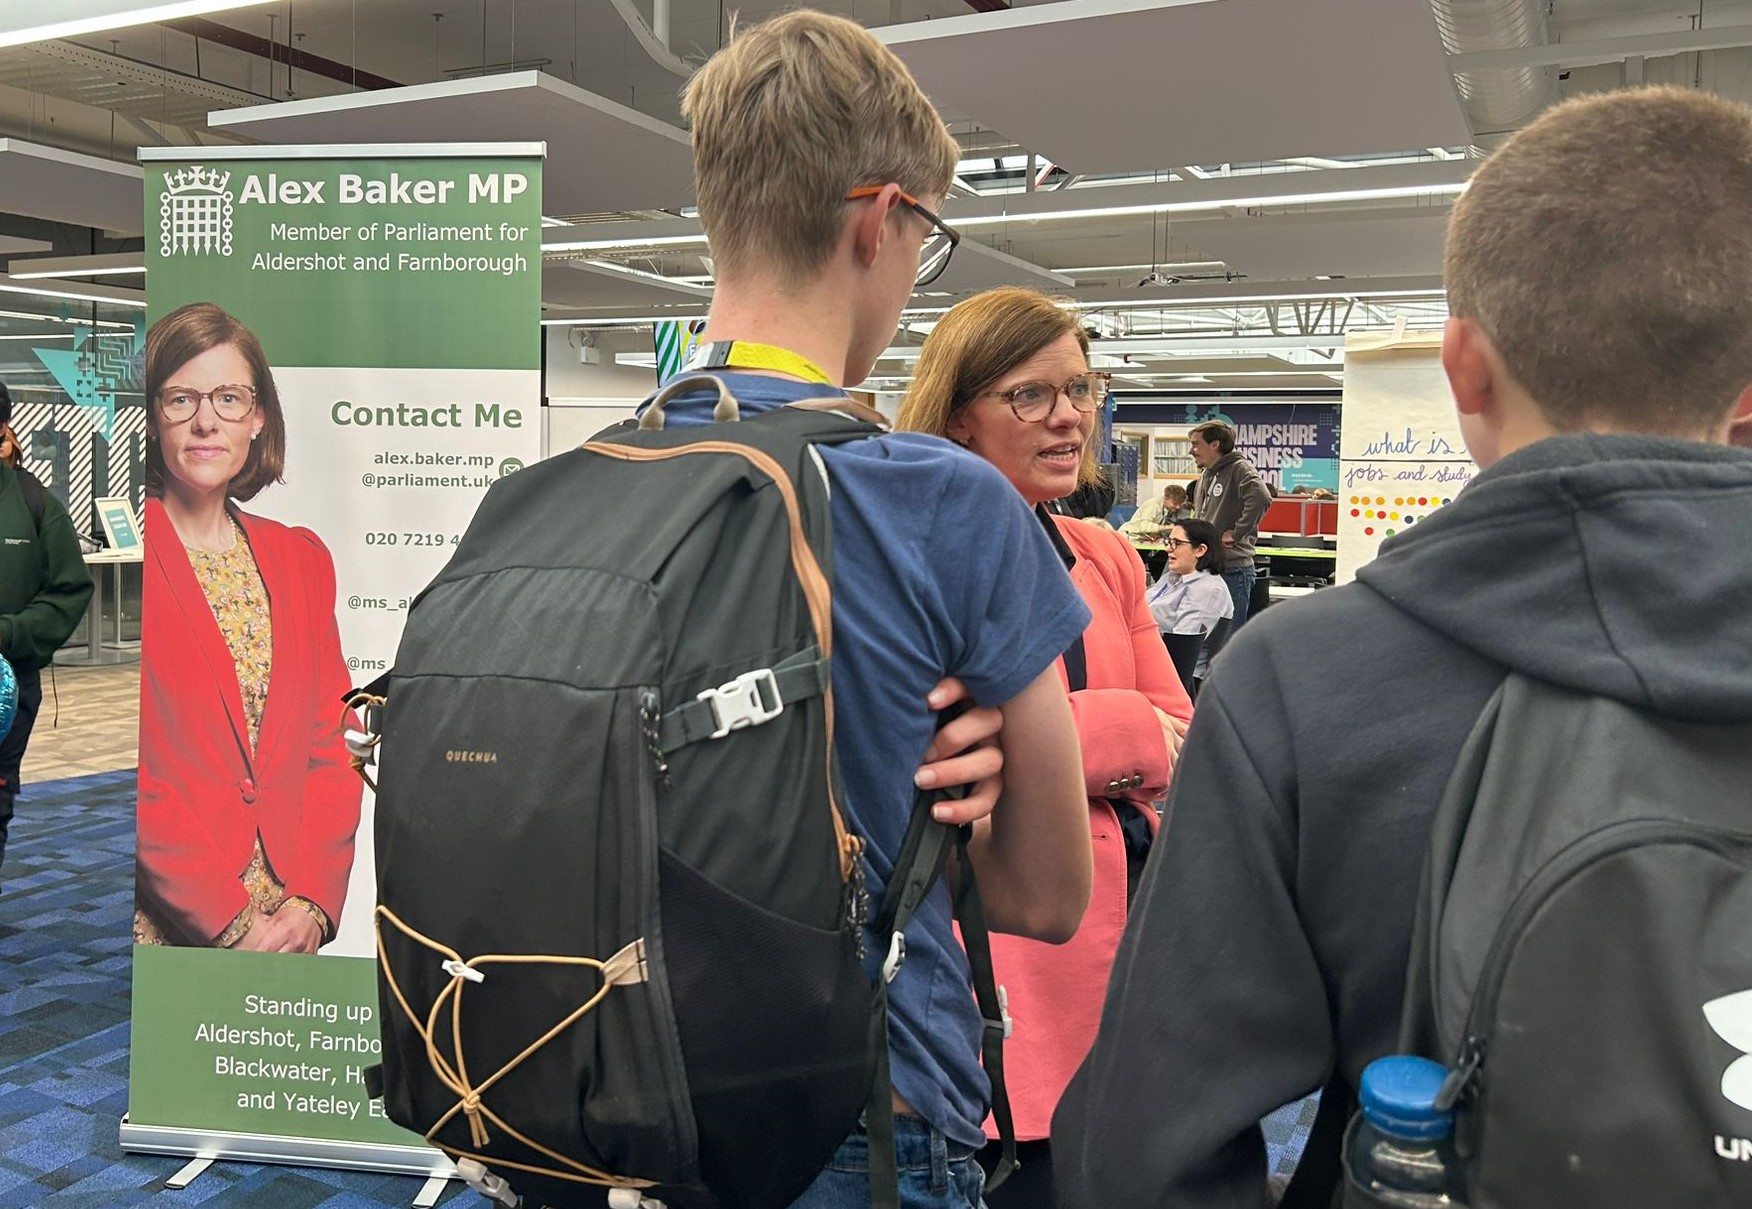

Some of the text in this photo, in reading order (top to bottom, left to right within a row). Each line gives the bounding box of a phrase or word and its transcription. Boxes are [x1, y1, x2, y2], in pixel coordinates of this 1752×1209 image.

[239, 173, 528, 204] Alex Baker MP
[270, 222, 529, 242] Member of Parliament for
[252, 252, 528, 276] Aldershot and Farnborough
[331, 400, 522, 428] Contact Me
[1362, 427, 1454, 457] what is
[374, 451, 494, 469] alex.baker.mp
[362, 473, 493, 489] @parliament.uk
[1345, 463, 1388, 488] jobs
[1393, 464, 1427, 482] and
[365, 532, 398, 546] 020
[403, 533, 445, 547] 7219
[446, 750, 497, 762] QUECHUA
[245, 994, 373, 1025] Standing up
[194, 1023, 381, 1054] Aldershot, Farnbo
[215, 1056, 365, 1087] Blackwater, H
[237, 1090, 275, 1110] and
[283, 1092, 361, 1121] Yateley
